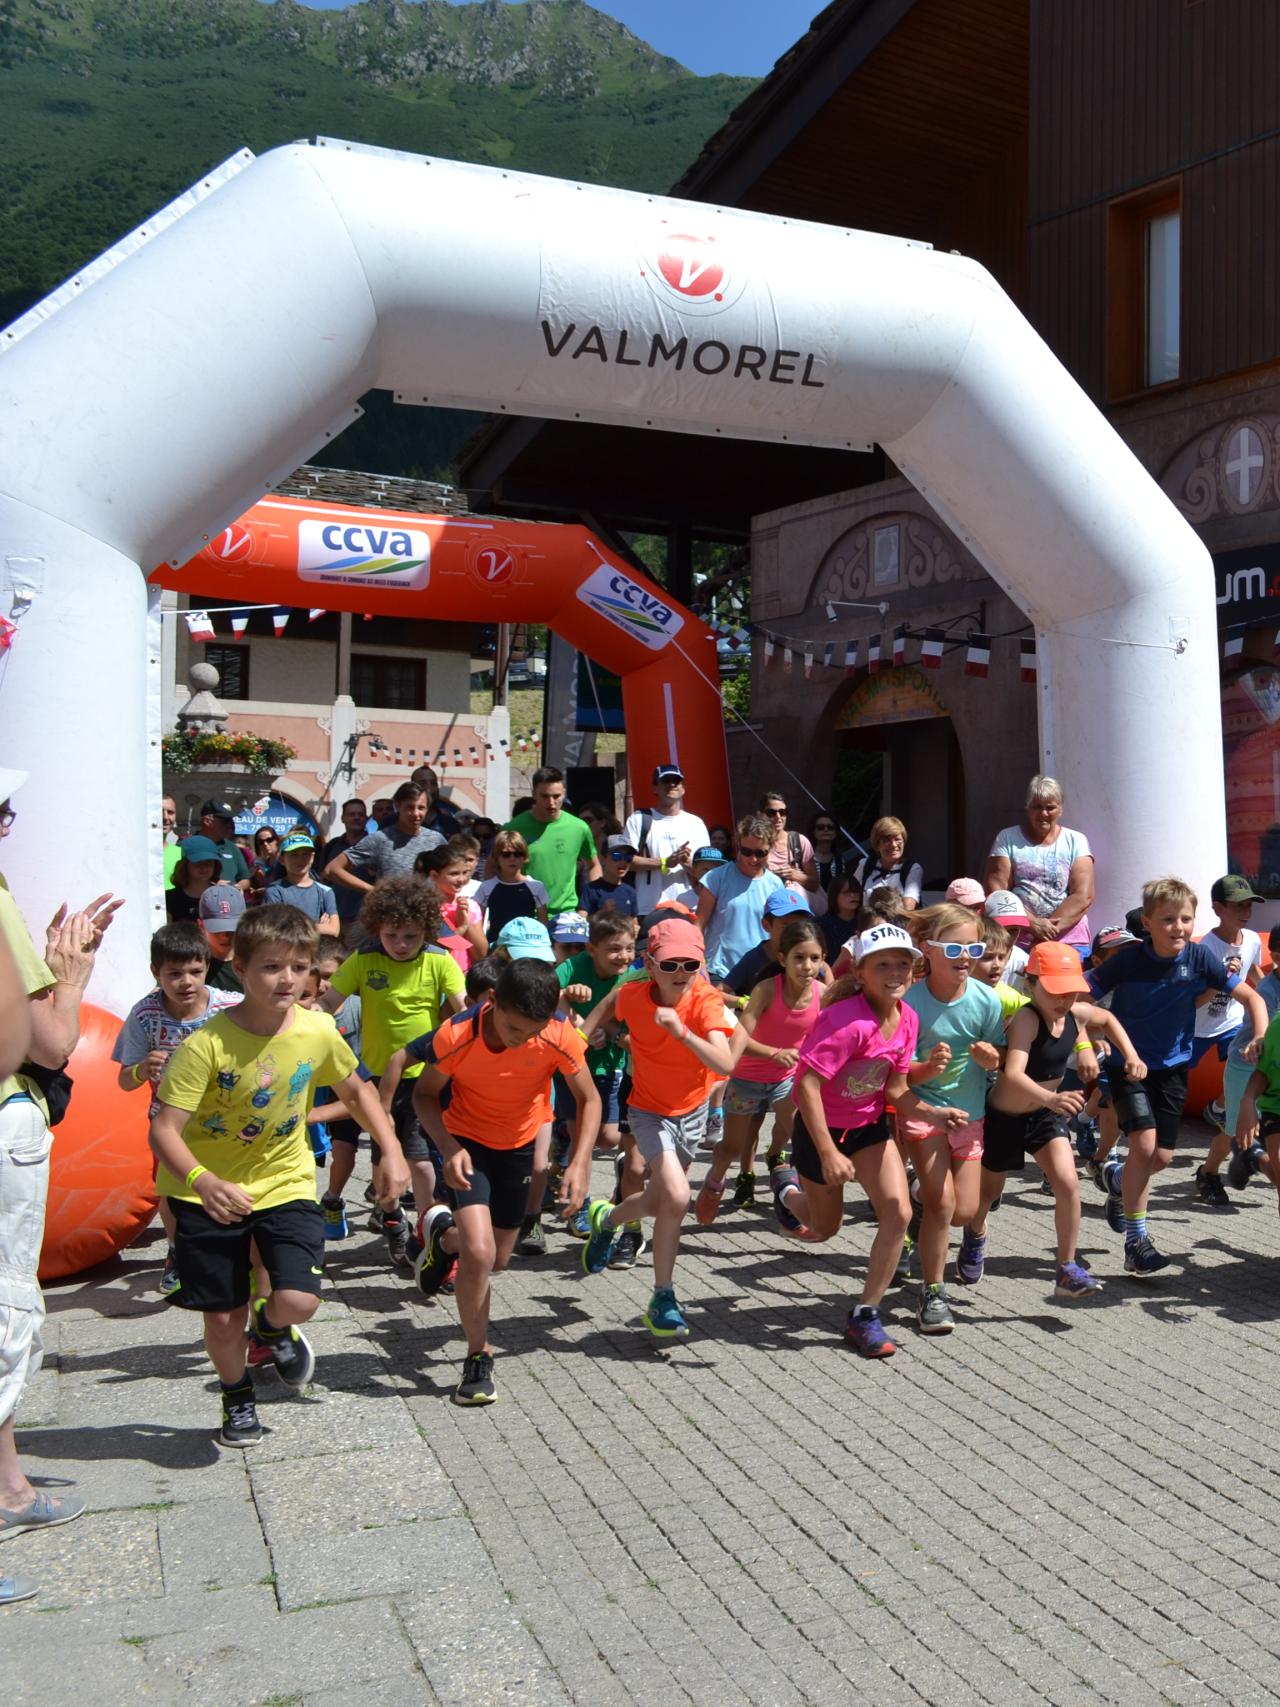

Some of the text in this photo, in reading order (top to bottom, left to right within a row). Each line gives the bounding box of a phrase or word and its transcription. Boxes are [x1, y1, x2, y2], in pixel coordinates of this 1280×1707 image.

[541, 320, 825, 388] VALMOREL
[321, 525, 413, 556] ccva
[609, 575, 673, 626] ccva
[256, 816, 268, 824] DE
[270, 816, 298, 825] VENTE
[870, 926, 906, 942] STAFF
